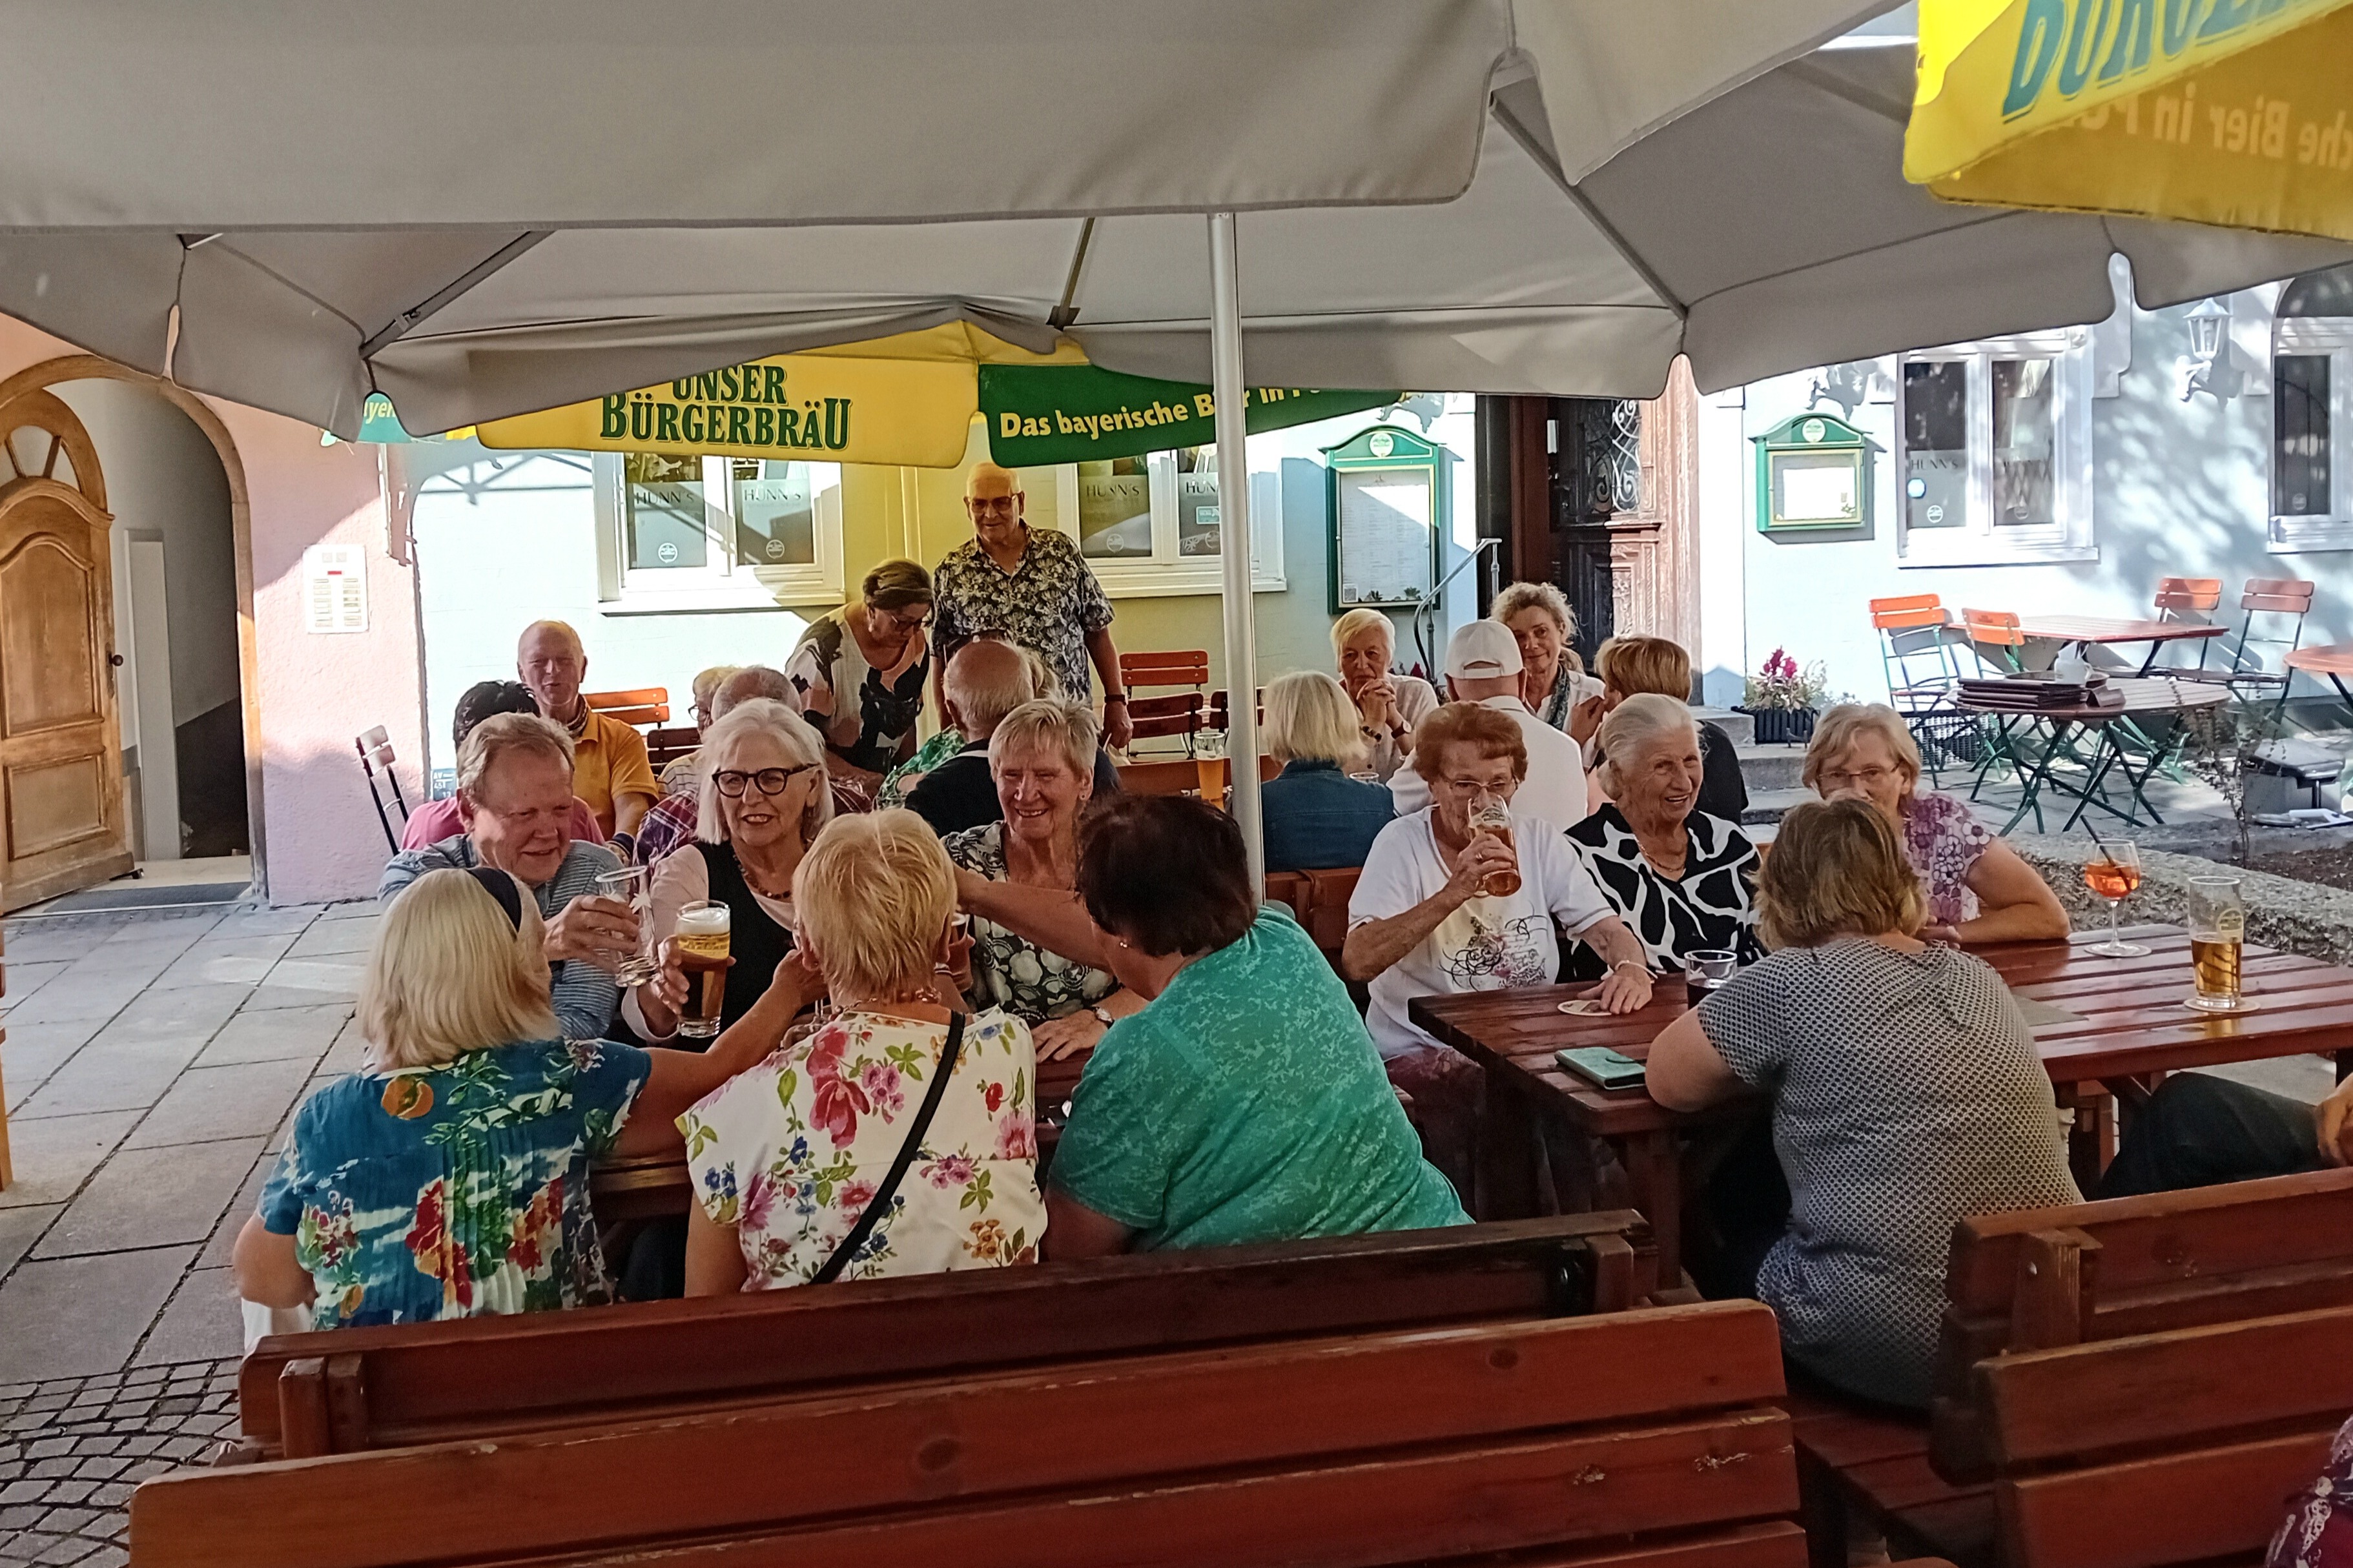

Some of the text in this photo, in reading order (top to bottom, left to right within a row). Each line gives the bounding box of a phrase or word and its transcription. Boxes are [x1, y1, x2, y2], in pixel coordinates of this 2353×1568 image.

[672, 364, 787, 405] UNSER
[600, 392, 852, 450] BÜRGERBRÄU
[1000, 412, 1051, 438] Das
[1055, 401, 1189, 440] bayerische
